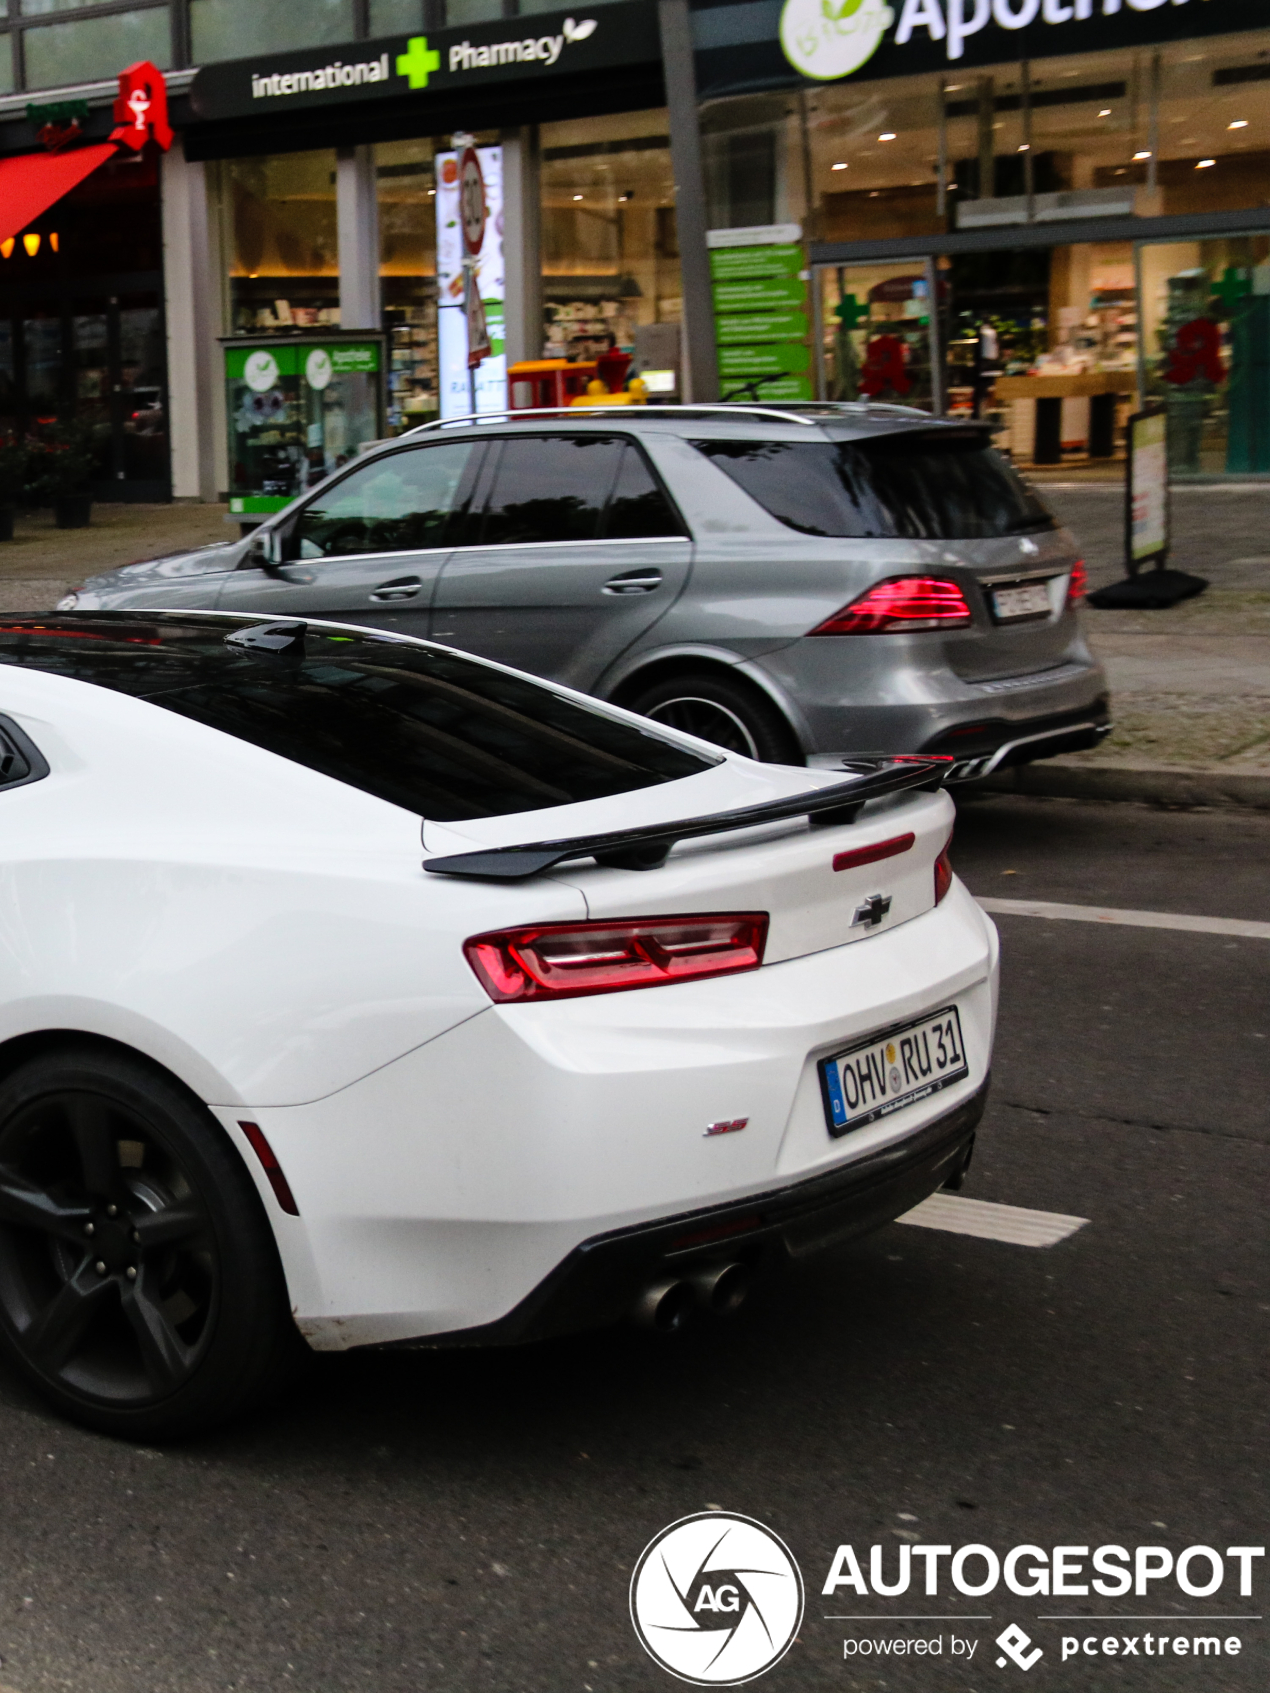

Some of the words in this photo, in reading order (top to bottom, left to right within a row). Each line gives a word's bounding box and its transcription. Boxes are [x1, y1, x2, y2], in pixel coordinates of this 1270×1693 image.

[894, 0, 1208, 59] Apot
[252, 53, 389, 98] international
[449, 35, 564, 73] Pharmacy
[451, 381, 504, 393] RAATT
[842, 1048, 887, 1110] OHV
[899, 1030, 933, 1086] RU
[931, 1018, 962, 1070] 31
[702, 1116, 750, 1137] SS
